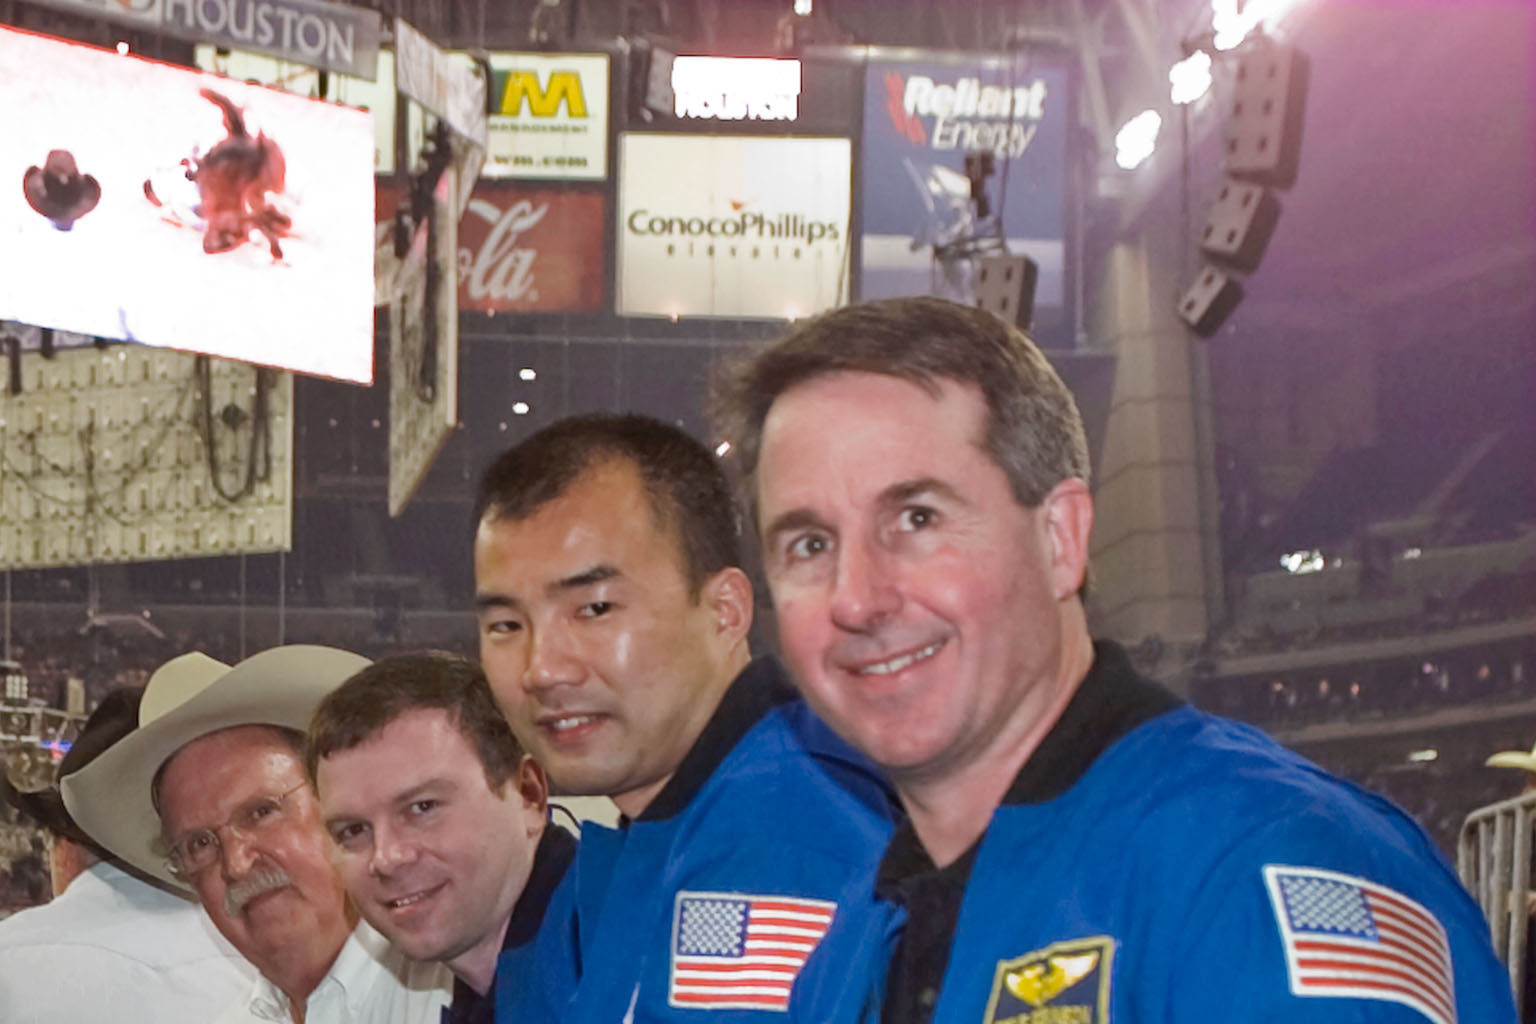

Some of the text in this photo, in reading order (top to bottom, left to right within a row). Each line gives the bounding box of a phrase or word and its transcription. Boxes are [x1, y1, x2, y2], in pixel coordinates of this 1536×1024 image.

[166, 0, 355, 65] HOUSTON
[904, 75, 1048, 120] Reliant
[932, 117, 1037, 160] Energy
[627, 208, 840, 246] ConocoPhillips
